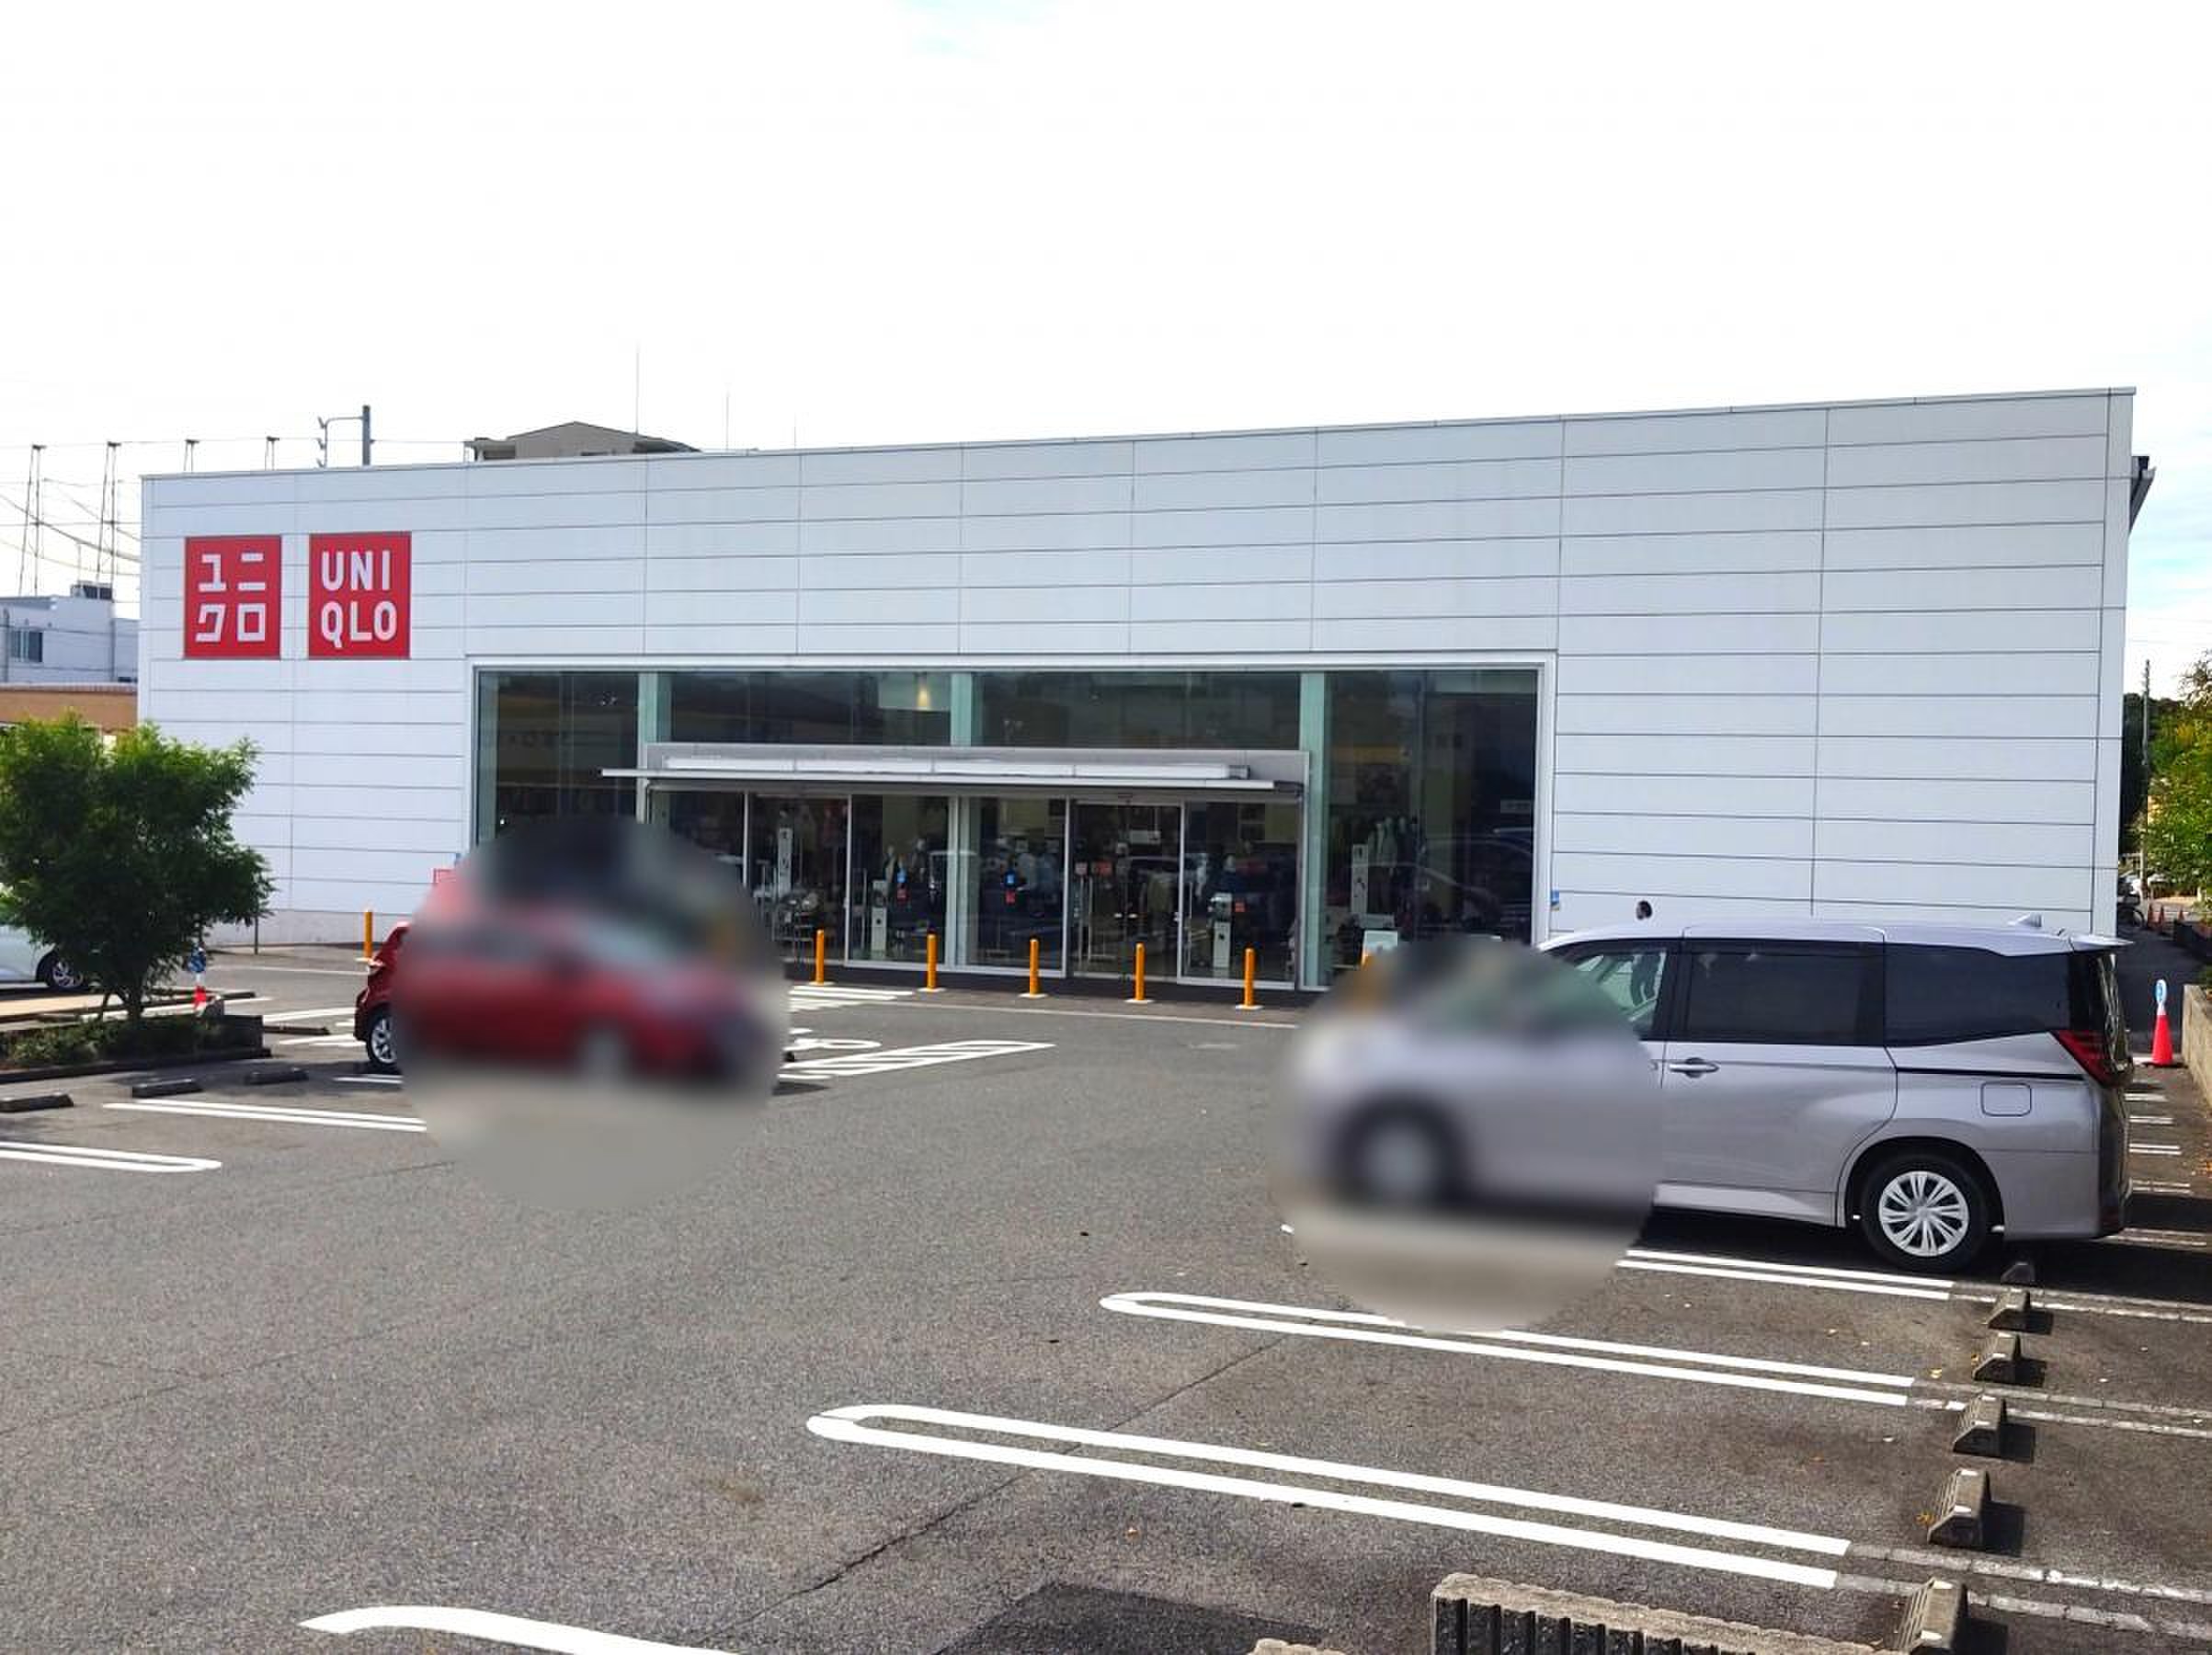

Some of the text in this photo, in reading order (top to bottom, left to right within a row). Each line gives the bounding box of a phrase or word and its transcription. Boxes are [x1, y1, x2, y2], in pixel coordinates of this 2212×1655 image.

[198, 553, 267, 592] ユニ
[321, 550, 392, 591] UNI
[195, 602, 267, 643] クロ
[321, 600, 397, 649] QLO
